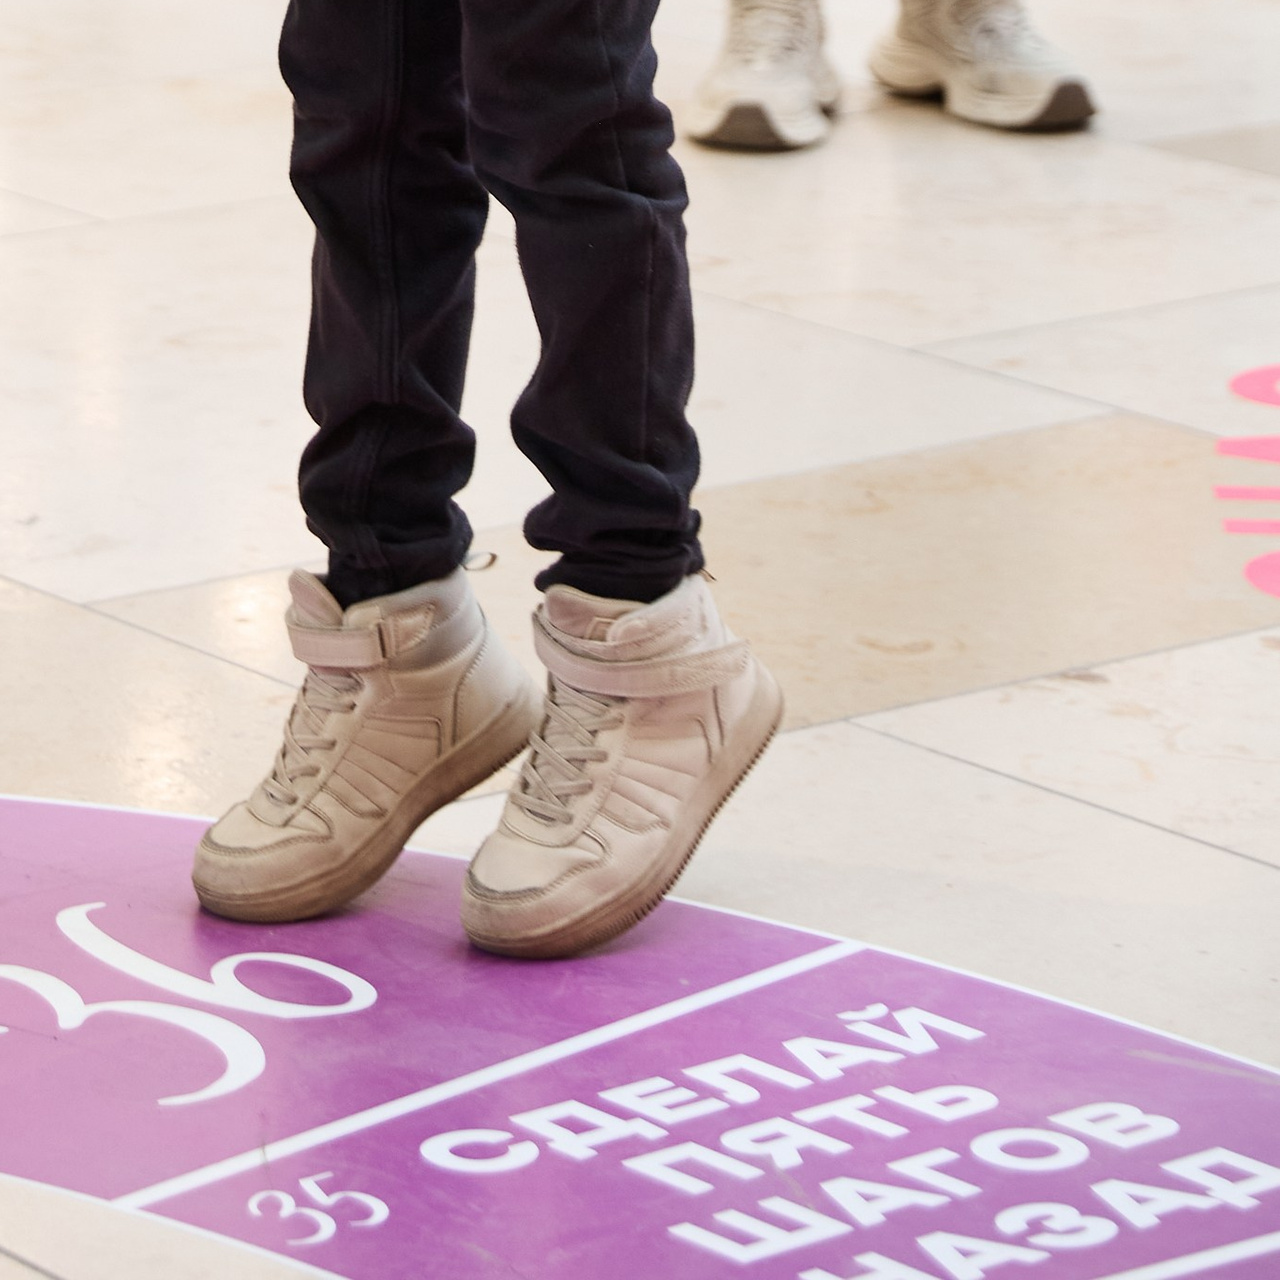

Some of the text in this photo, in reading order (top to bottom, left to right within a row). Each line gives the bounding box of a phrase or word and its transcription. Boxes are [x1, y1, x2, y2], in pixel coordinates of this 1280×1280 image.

[419, 1002, 986, 1172] СДЕЛАЙ
[622, 1085, 999, 1195] ПЯТЬ
[247, 1171, 390, 1247] 35
[668, 1101, 1180, 1264] ШАГОВ
